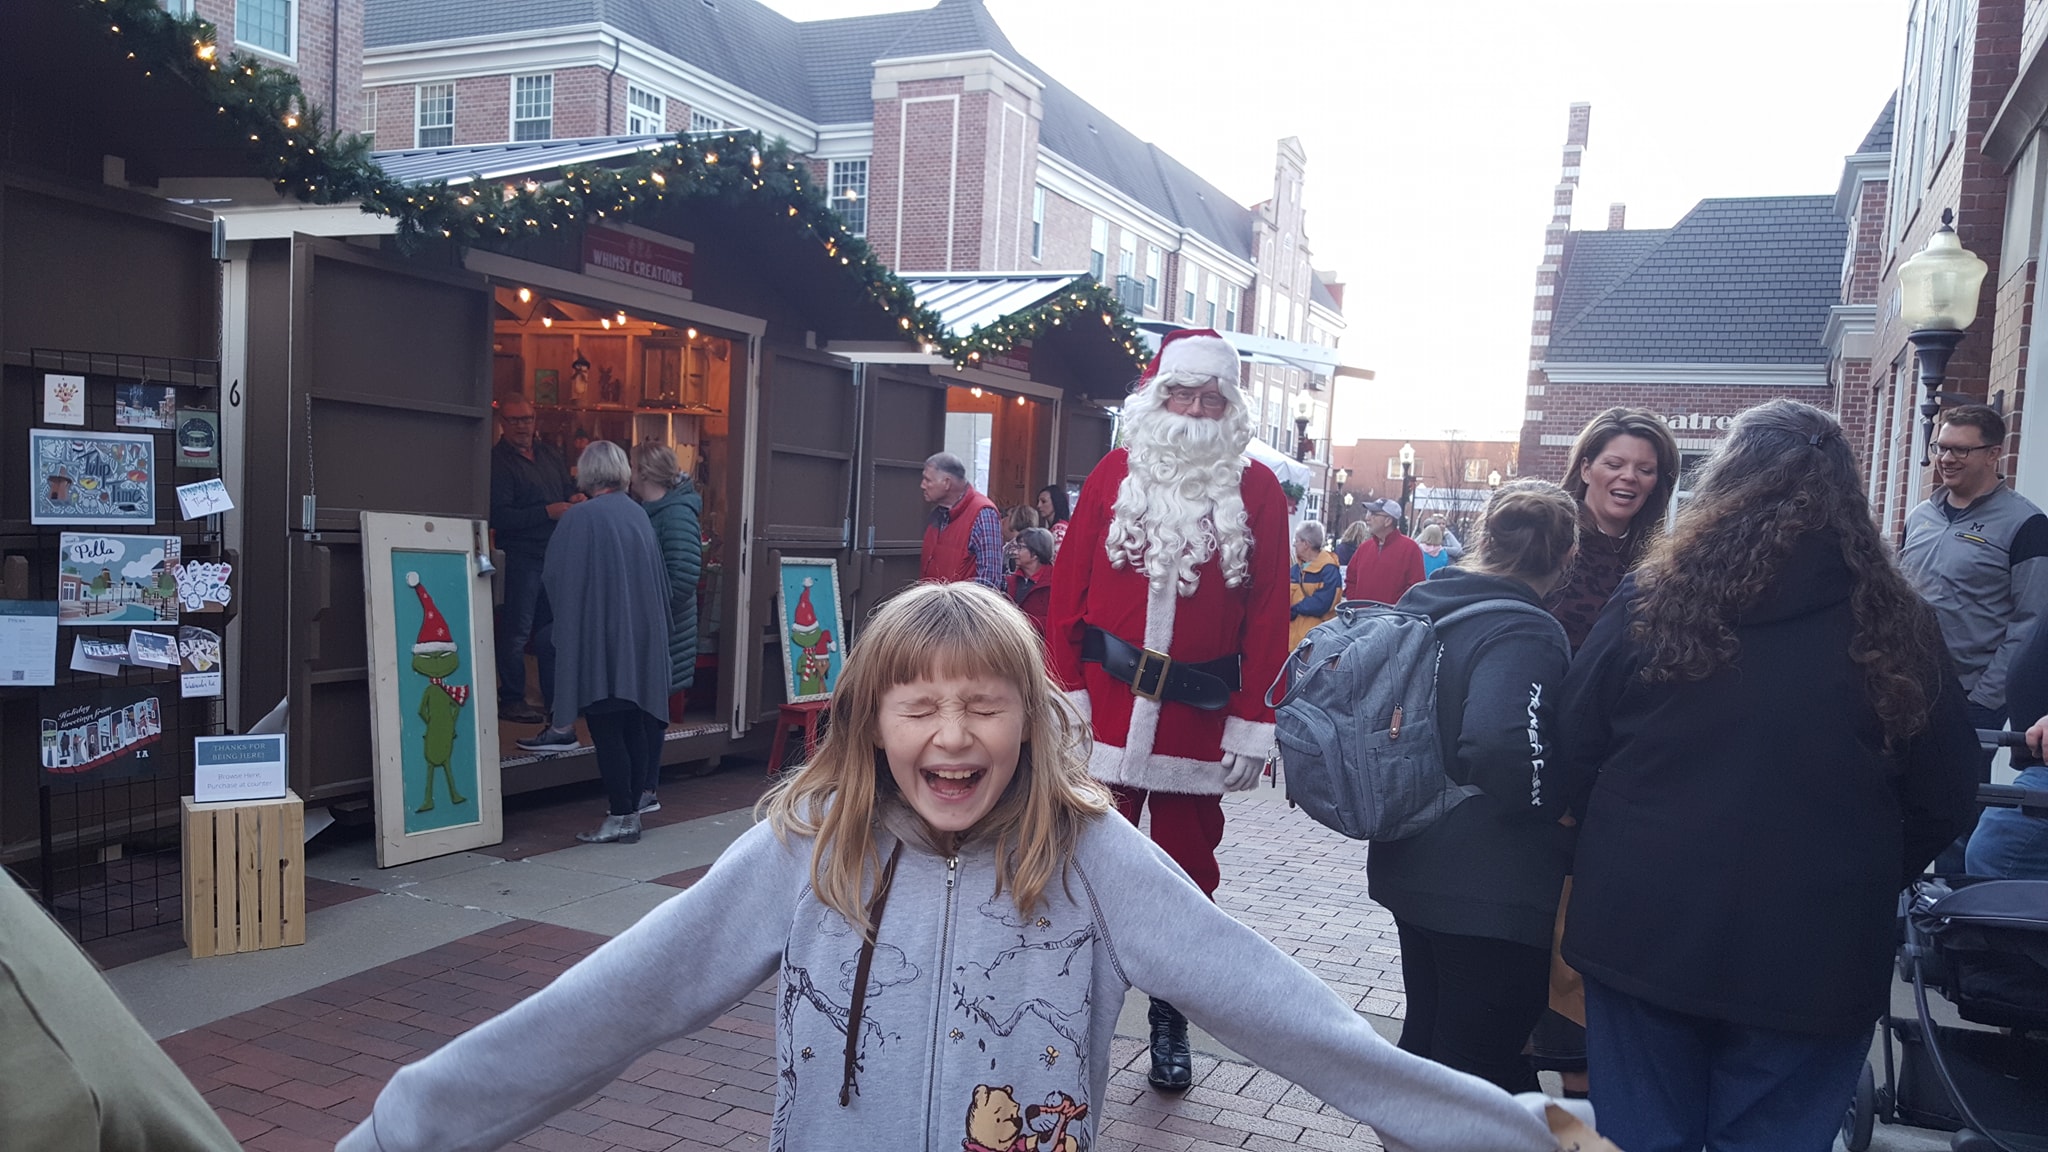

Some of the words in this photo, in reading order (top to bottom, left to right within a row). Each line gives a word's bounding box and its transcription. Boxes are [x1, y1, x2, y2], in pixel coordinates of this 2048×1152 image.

[592, 249, 632, 273] WHIMSY
[633, 260, 684, 286] CREATIONS
[229, 379, 241, 407] 6
[77, 449, 111, 489] Tulip
[1970, 522, 1985, 532] M
[74, 539, 115, 559] Pella
[57, 704, 91, 721] Holiday
[61, 714, 94, 729] Greetings
[94, 706, 112, 719] from
[136, 750, 149, 759] IA
[214, 743, 247, 752] THANKS
[249, 742, 266, 750] FOR
[212, 753, 238, 761] BEING
[240, 751, 265, 759] HERE!
[207, 782, 238, 790] Purchase
[247, 780, 273, 788] counter
